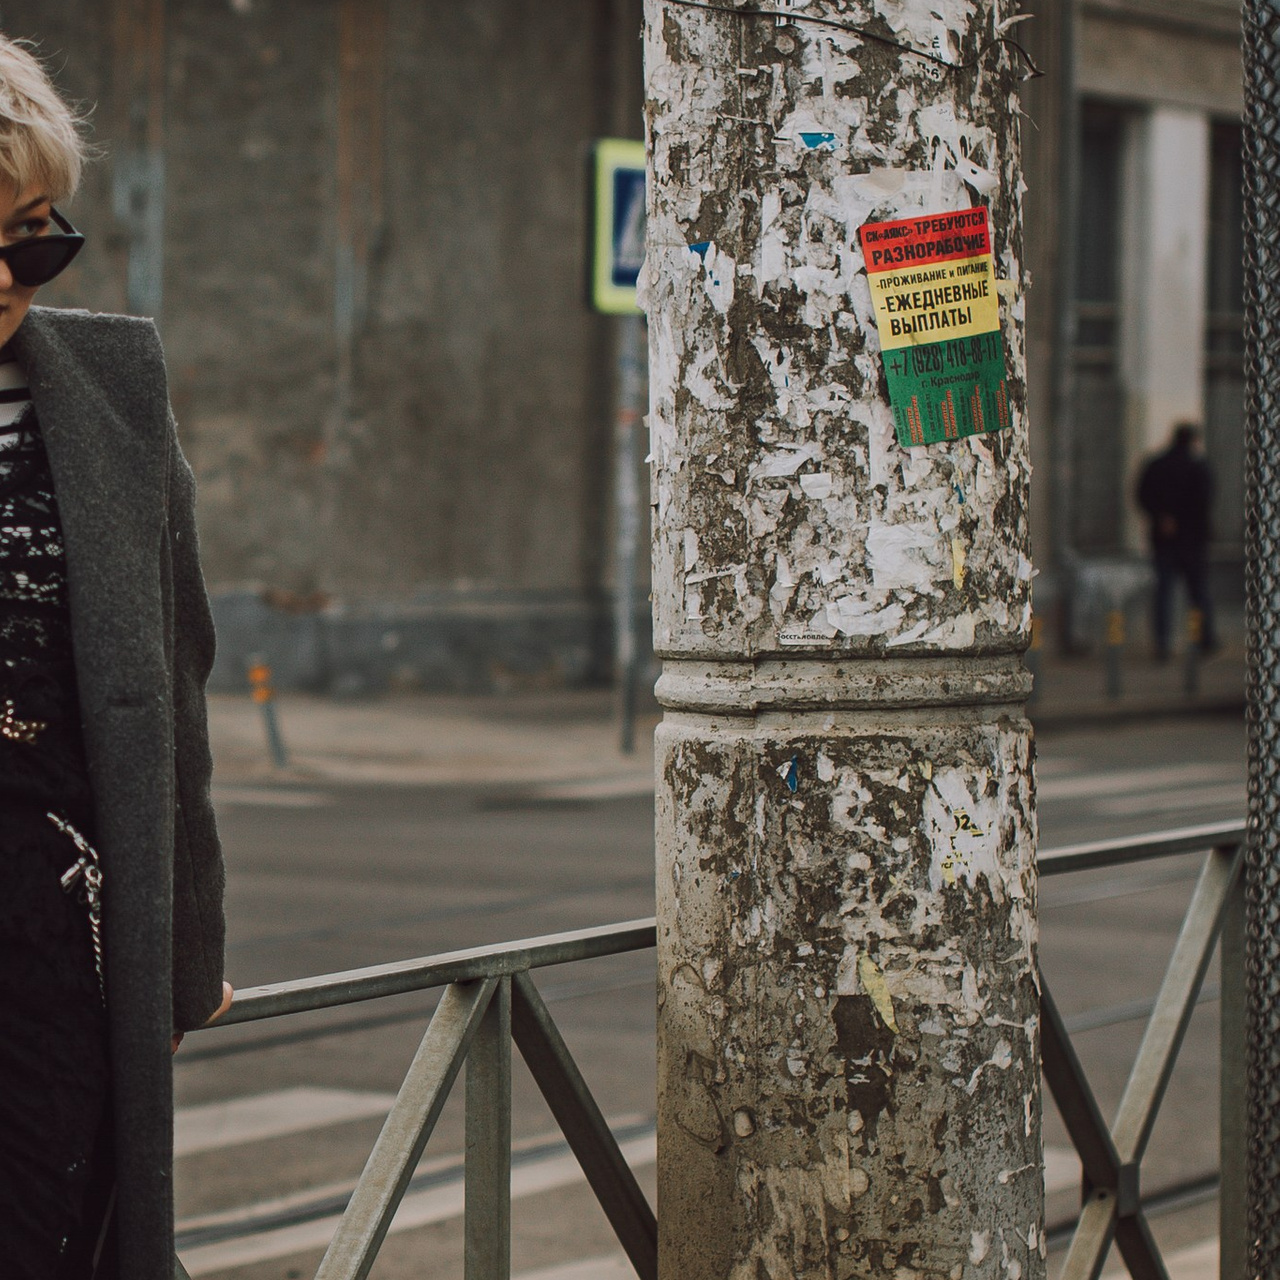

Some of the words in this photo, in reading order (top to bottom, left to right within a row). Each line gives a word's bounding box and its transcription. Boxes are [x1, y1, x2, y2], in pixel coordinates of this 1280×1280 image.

[914, 211, 985, 235] ТРЕБУЮТСЯ
[872, 233, 985, 265] РАЗНОРАБОЧИЕ
[880, 280, 989, 313] -ЕЖЕДНЕВНЫЕ
[890, 306, 972, 336] ВЫПЛАТЫ
[890, 349, 908, 376] +7
[911, 344, 944, 378] (928)
[946, 334, 998, 368] 418-88-11
[930, 370, 980, 388] Краснодар
